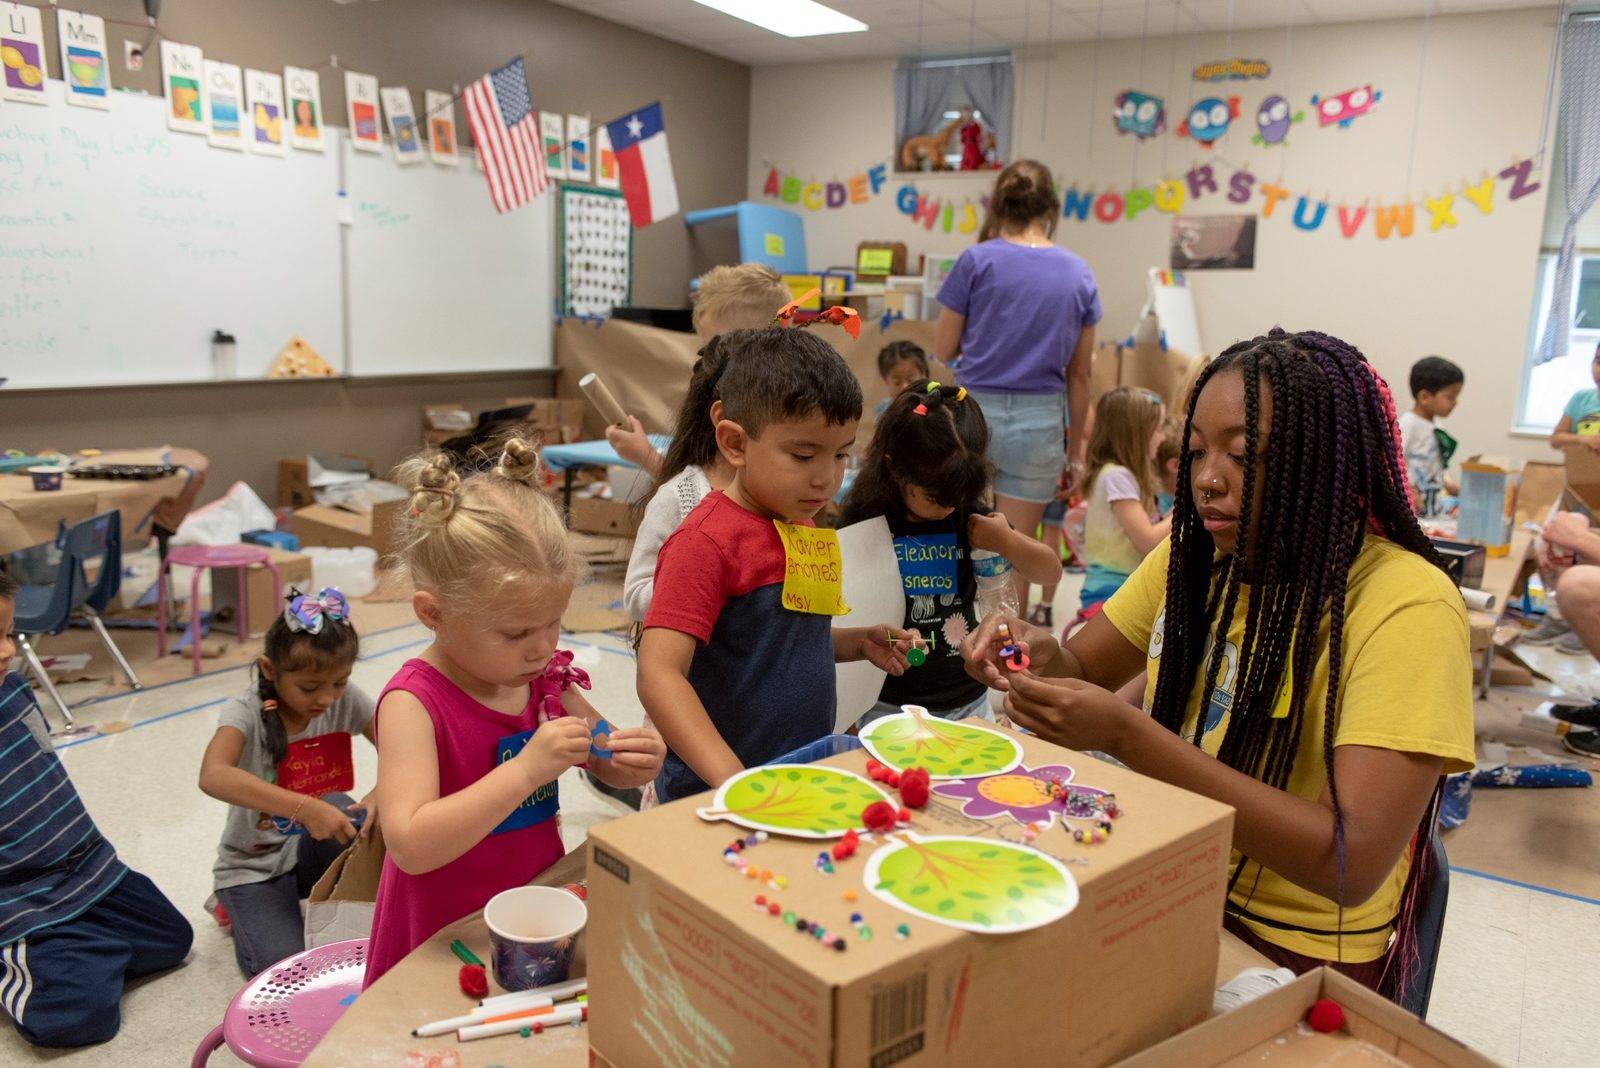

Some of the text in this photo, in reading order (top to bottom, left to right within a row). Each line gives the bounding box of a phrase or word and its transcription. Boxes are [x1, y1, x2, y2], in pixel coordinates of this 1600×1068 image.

[67, 21, 98, 44] Mm
[894, 544, 956, 562] Eleanor
[787, 557, 839, 583] Briones
[903, 575, 953, 590] sneros
